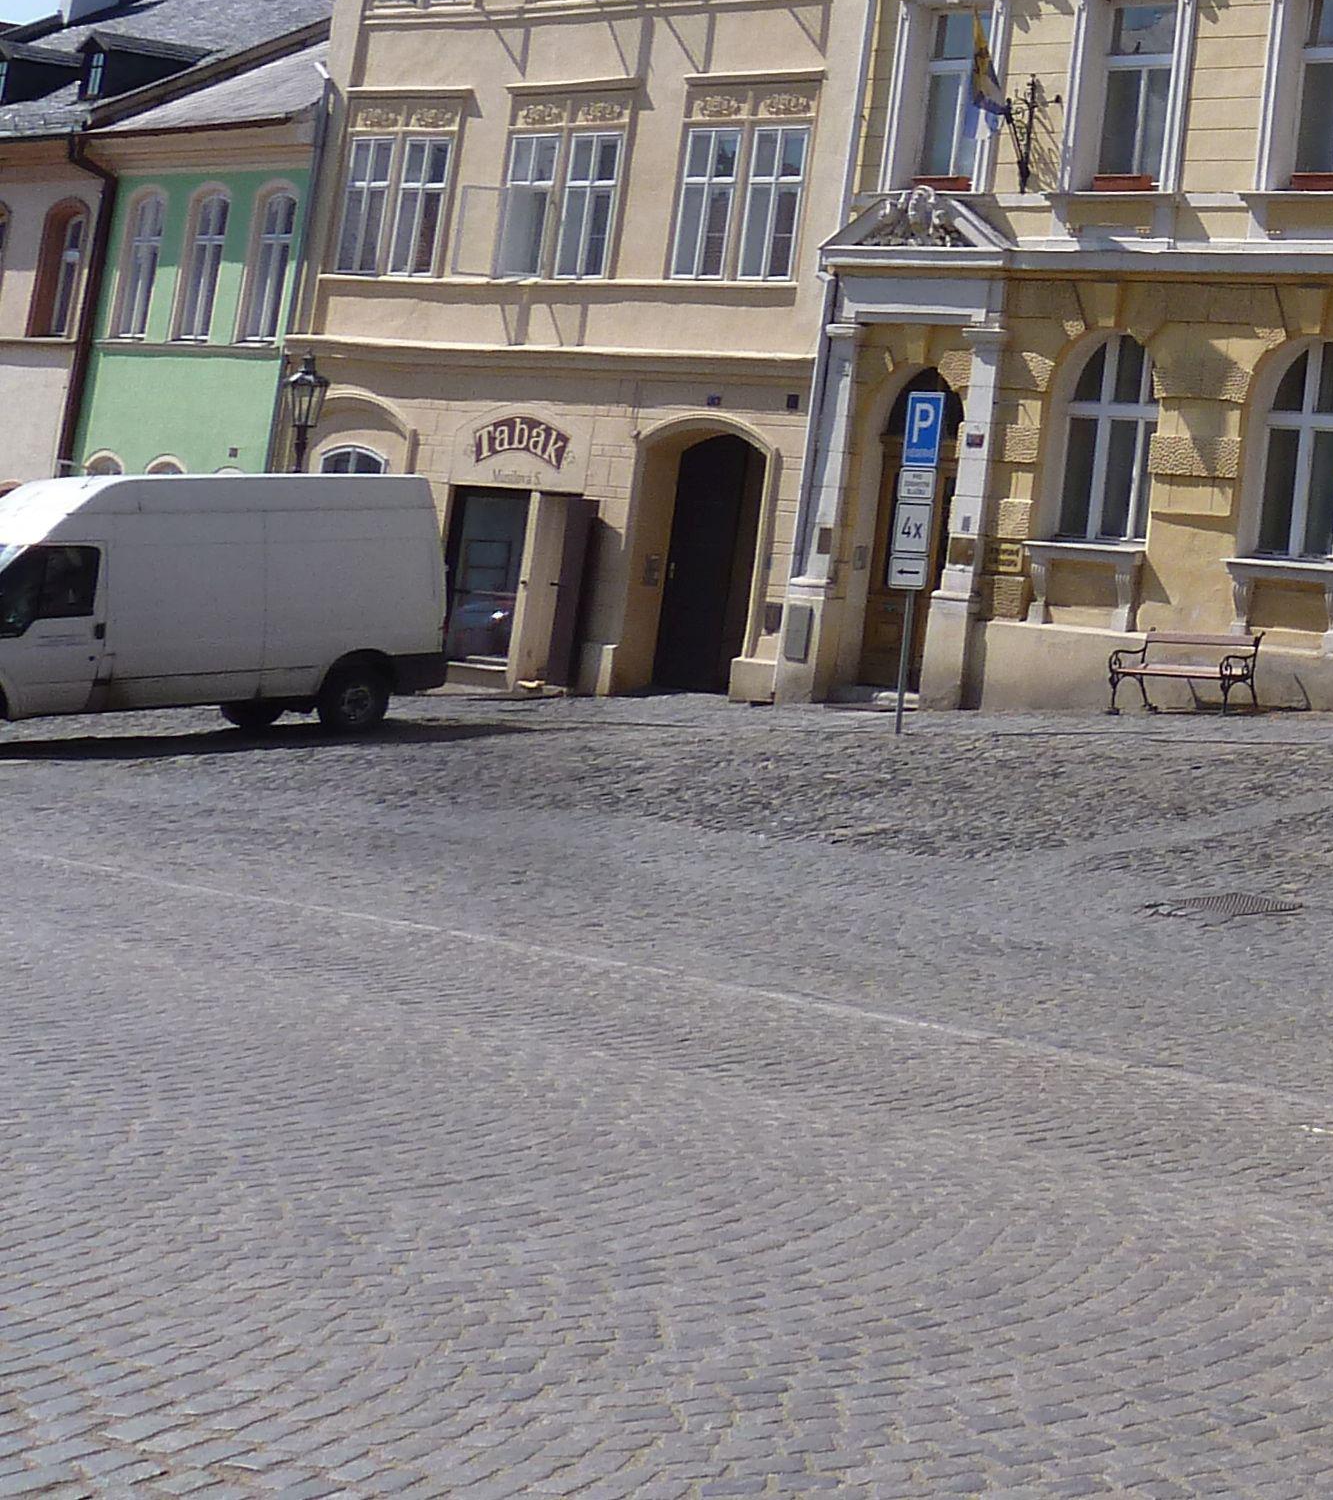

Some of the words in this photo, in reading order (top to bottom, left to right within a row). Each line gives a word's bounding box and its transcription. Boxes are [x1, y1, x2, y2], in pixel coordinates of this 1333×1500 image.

[476, 418, 564, 466] Tabák
[911, 403, 935, 443] P
[901, 516, 923, 539] 4x
